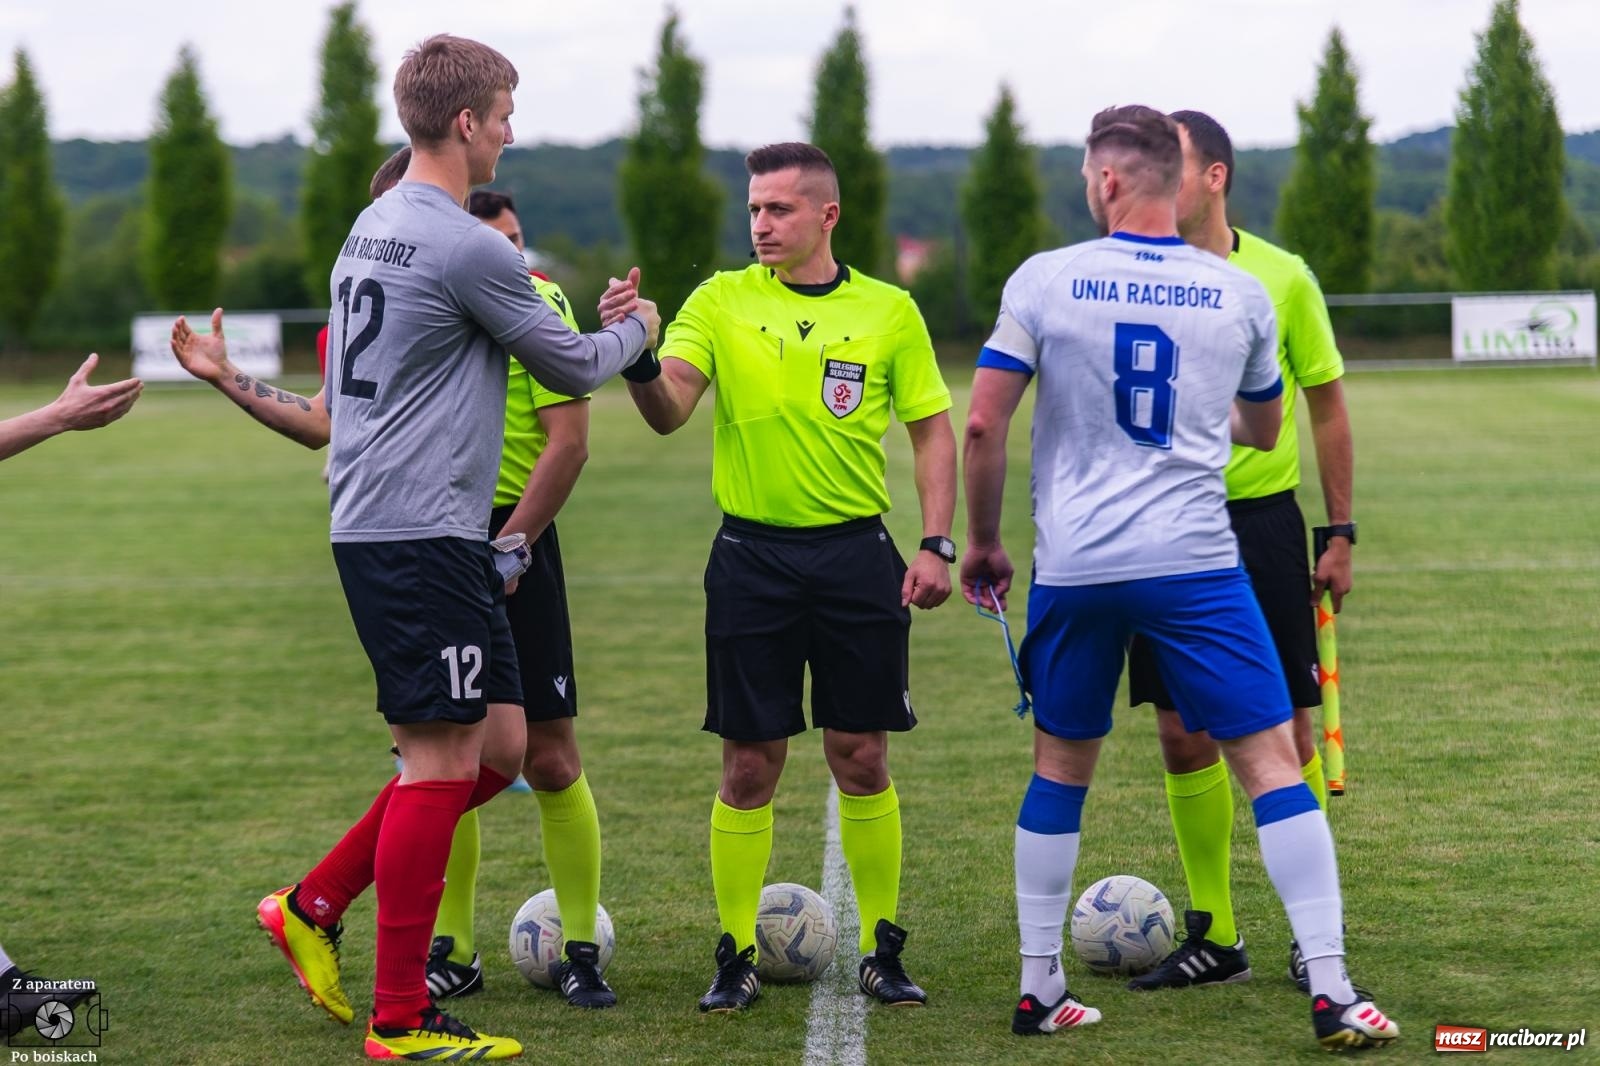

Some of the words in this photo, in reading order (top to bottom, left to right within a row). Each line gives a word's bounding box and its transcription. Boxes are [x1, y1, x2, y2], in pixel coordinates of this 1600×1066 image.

[341, 235, 360, 258] NIA
[357, 237, 417, 268] RACIBÓRZ
[1072, 279, 1120, 303] UNIA
[1127, 282, 1223, 309] RACIBÓRZ
[338, 275, 386, 400] 12
[1113, 322, 1180, 450] 8
[440, 645, 483, 699] 12
